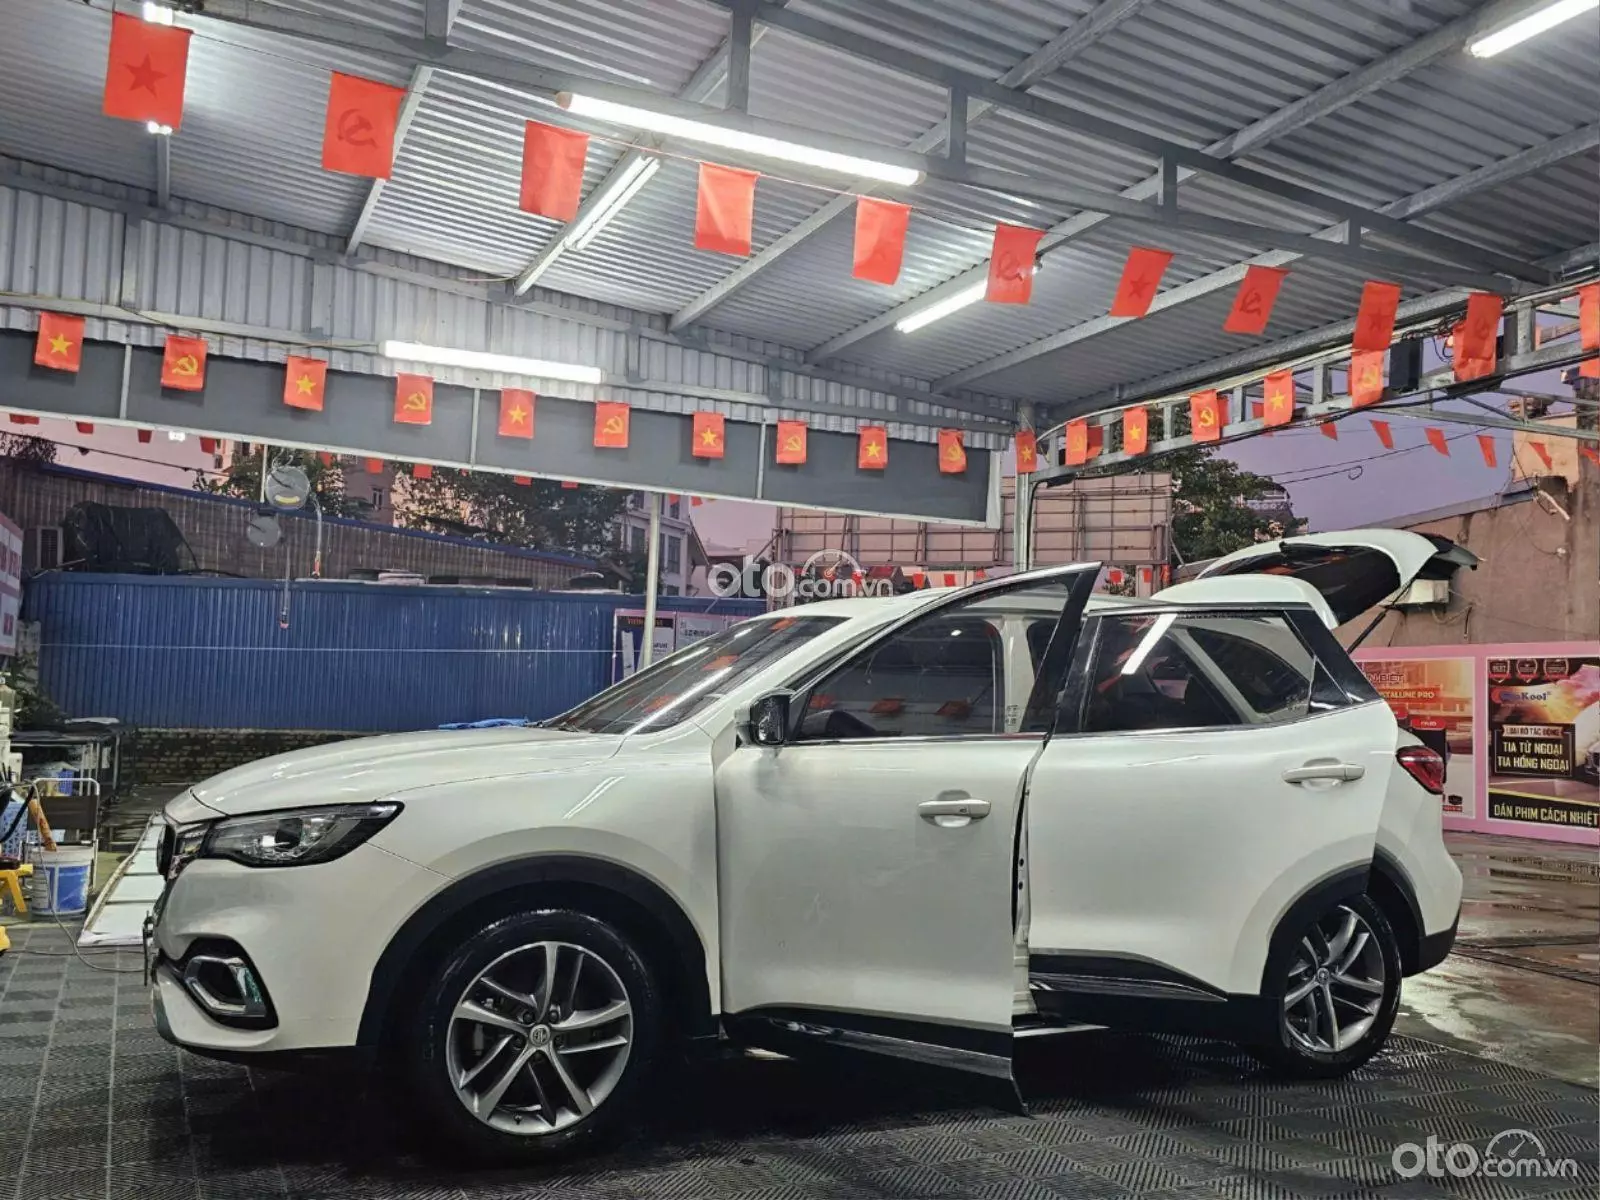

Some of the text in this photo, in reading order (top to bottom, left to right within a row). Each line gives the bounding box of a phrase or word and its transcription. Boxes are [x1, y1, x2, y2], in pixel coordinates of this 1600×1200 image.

[1418, 691, 1435, 699] PRO
[1530, 727, 1541, 736] TÁC
[1503, 741, 1517, 753] TIA
[1534, 742, 1563, 757] NGOẠI
[1497, 756, 1511, 767] TIA
[1540, 758, 1569, 772] NGOẠI
[1494, 802, 1599, 827] DÁN PHIM CÁCH NHIỆT
